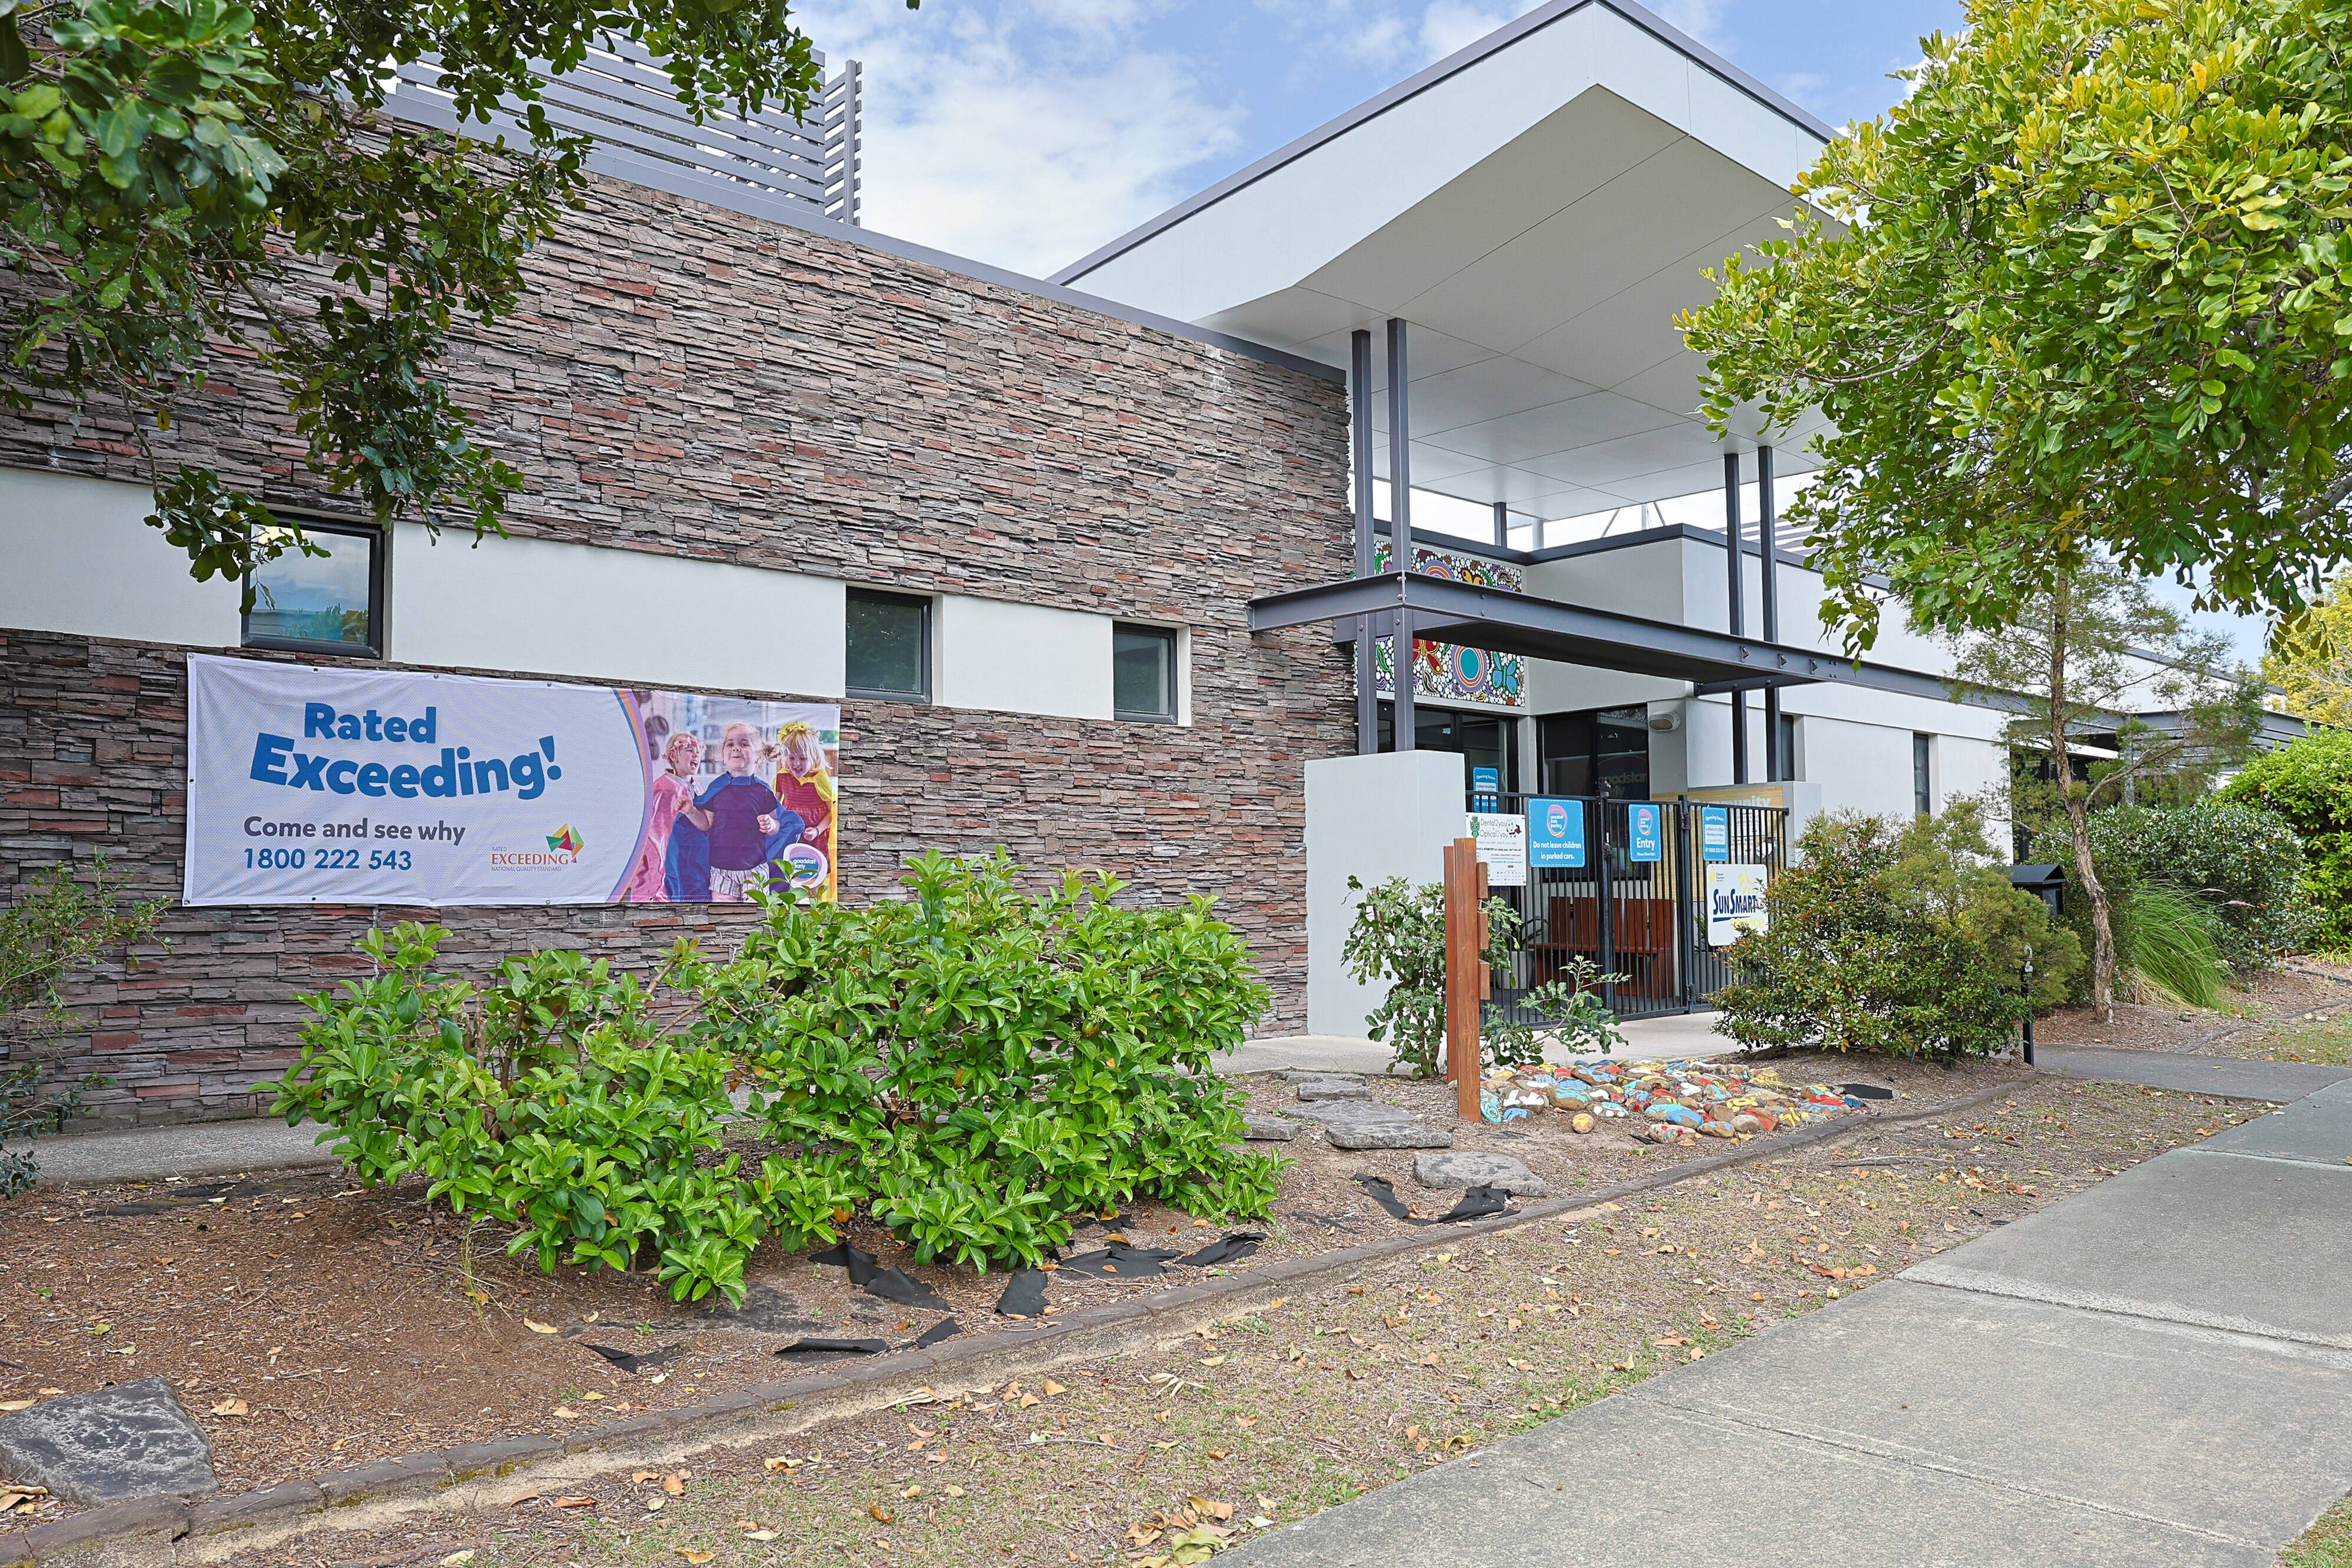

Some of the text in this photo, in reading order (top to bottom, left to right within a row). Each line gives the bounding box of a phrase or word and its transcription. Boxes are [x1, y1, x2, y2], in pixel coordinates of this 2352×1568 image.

[305, 703, 436, 744] Rated
[250, 733, 561, 800] Exceeding!
[1598, 772, 1647, 788] goodstar
[1481, 818, 1507, 828] Dental2you
[244, 816, 466, 846] Come and see why
[1480, 829, 1508, 839] Optical2you
[1563, 841, 1582, 849] children
[1636, 837, 1655, 851] Entry
[244, 848, 412, 870] 1800 222 543
[492, 853, 569, 864] EXCEEDING
[1546, 852, 1563, 861] parked
